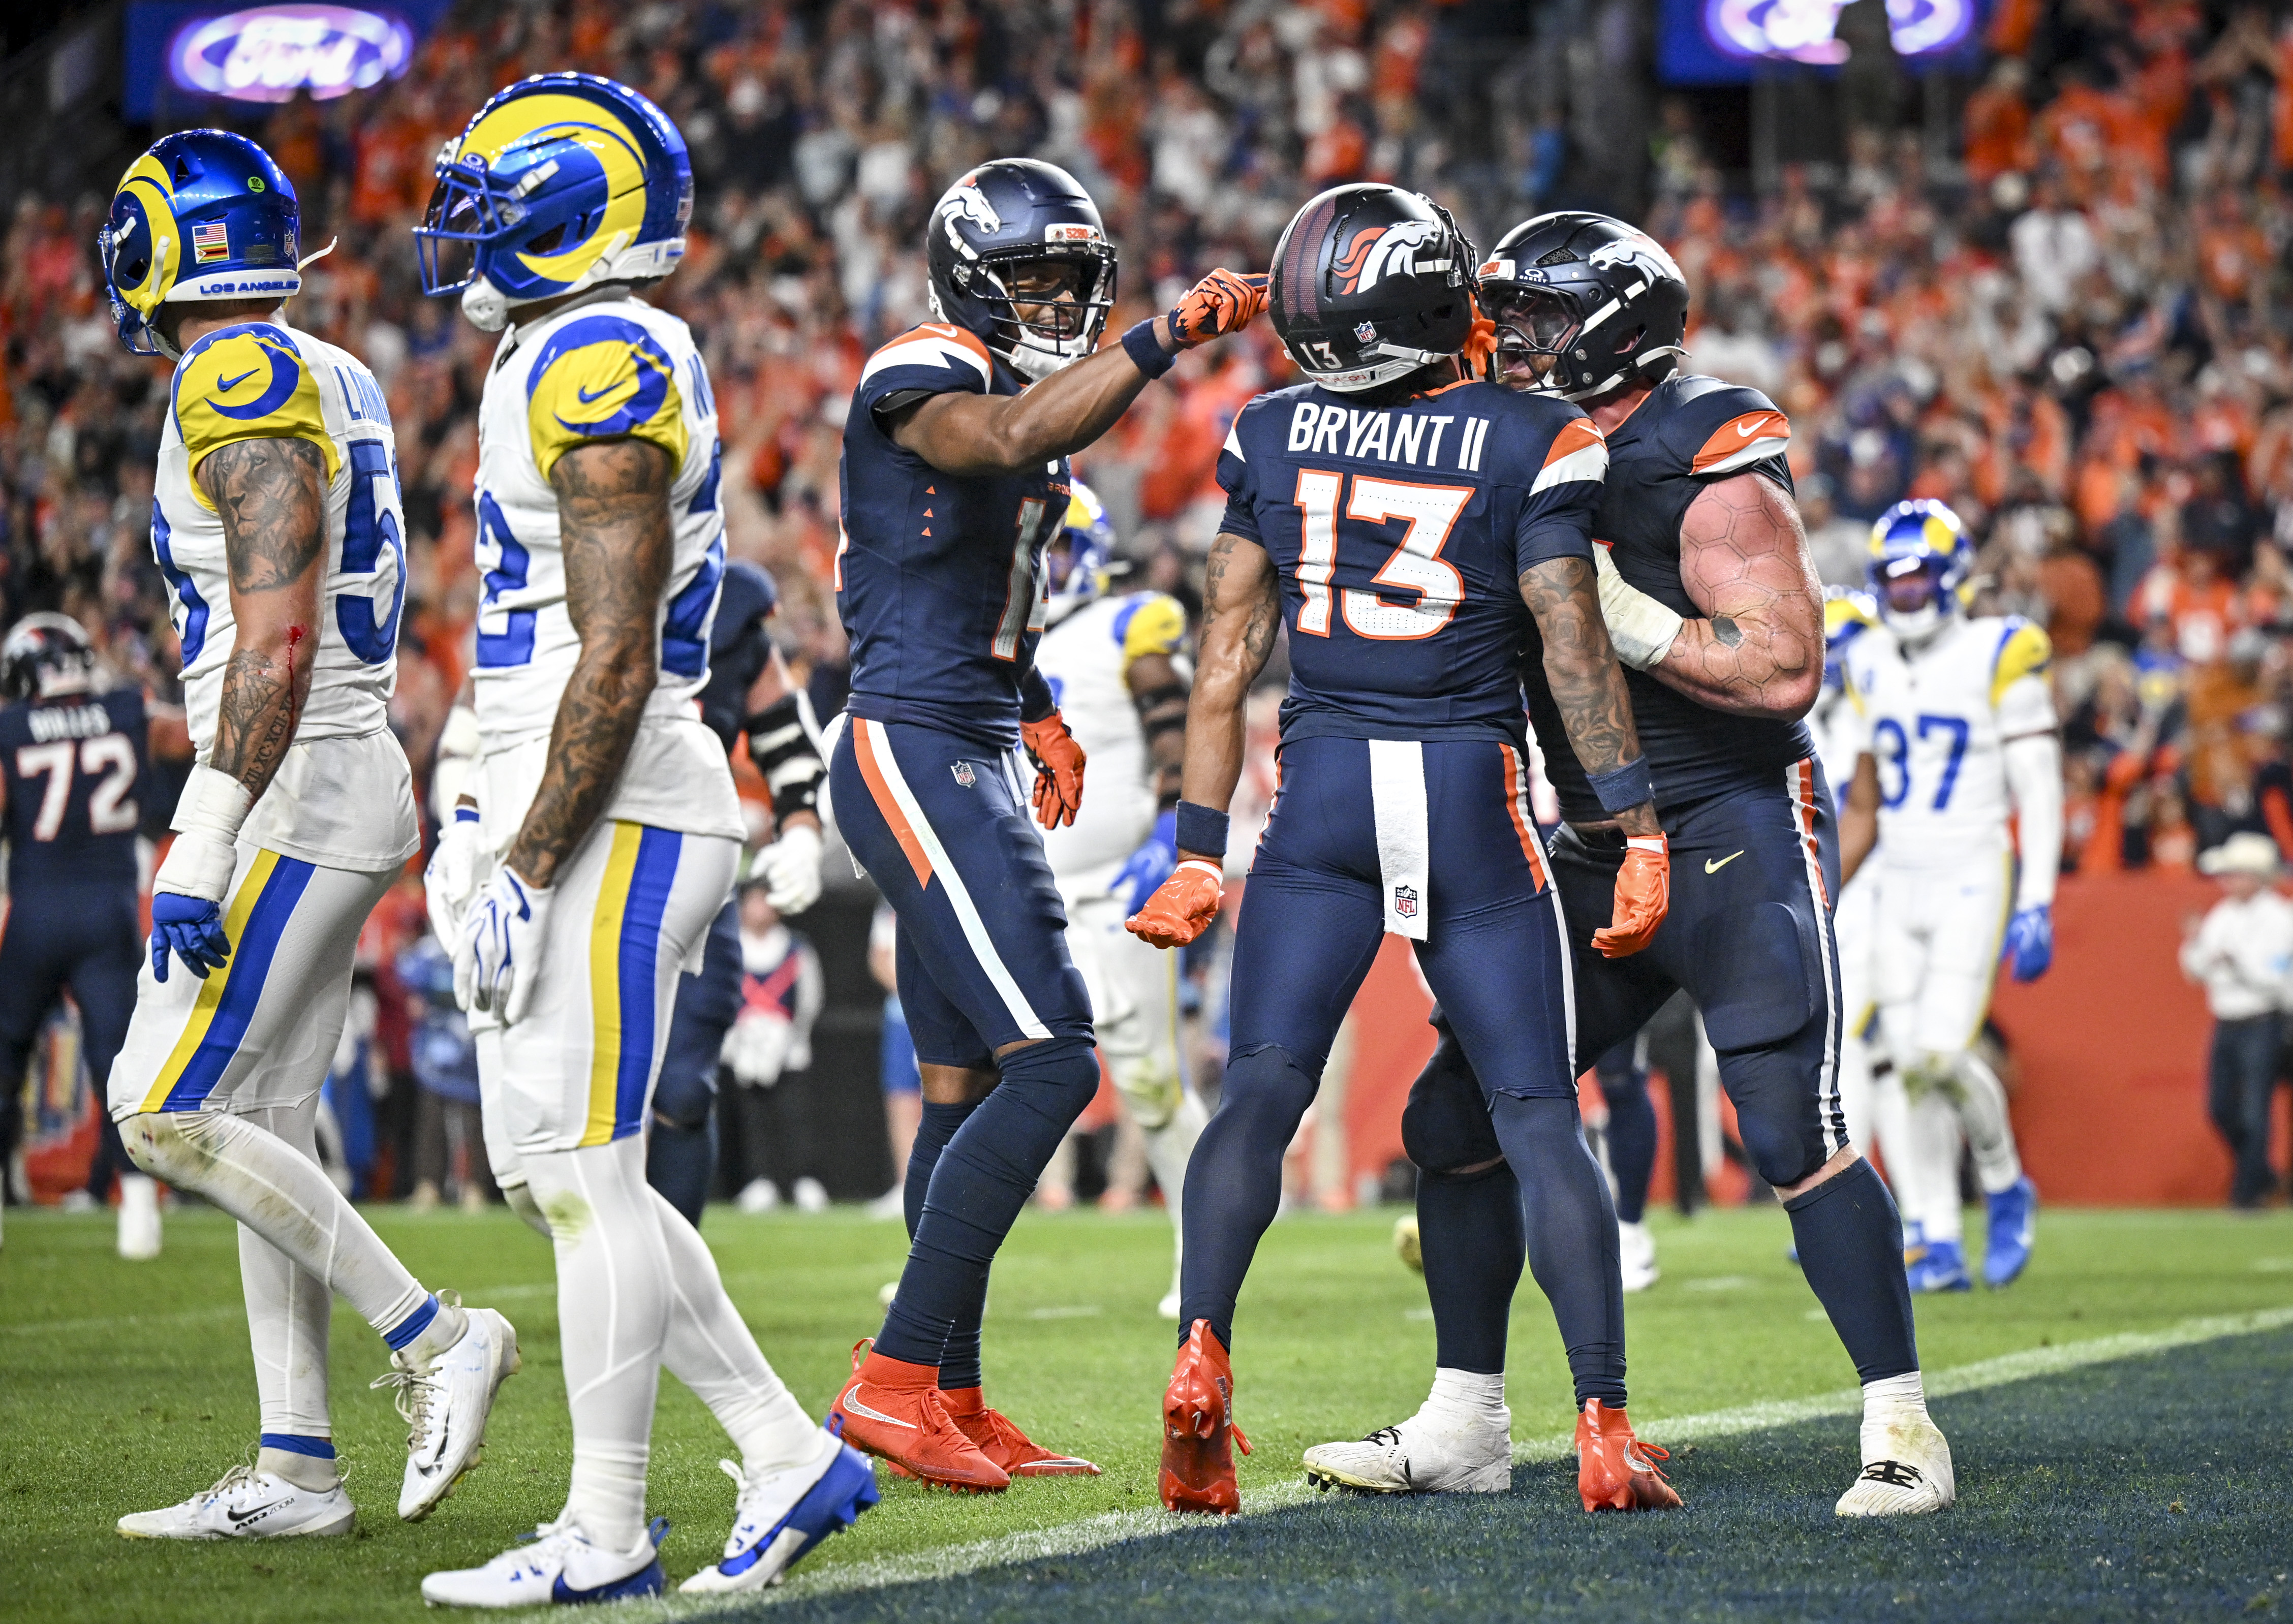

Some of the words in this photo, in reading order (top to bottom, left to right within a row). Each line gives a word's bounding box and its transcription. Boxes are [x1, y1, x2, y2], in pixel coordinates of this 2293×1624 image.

[200, 283, 235, 294] LOS
[237, 280, 299, 292] ANGELES
[1519, 274, 1547, 284] OAKLEY
[1359, 330, 1374, 341] NFL
[1298, 341, 1343, 370] 13
[1287, 401, 1454, 467] BRYANT
[1458, 416, 1490, 472] II
[1293, 467, 1476, 641] 13
[958, 772, 973, 783] NFL
[16, 732, 139, 842] 72
[1397, 898, 1415, 914] NFL
[269, 1497, 295, 1515] ZOOM
